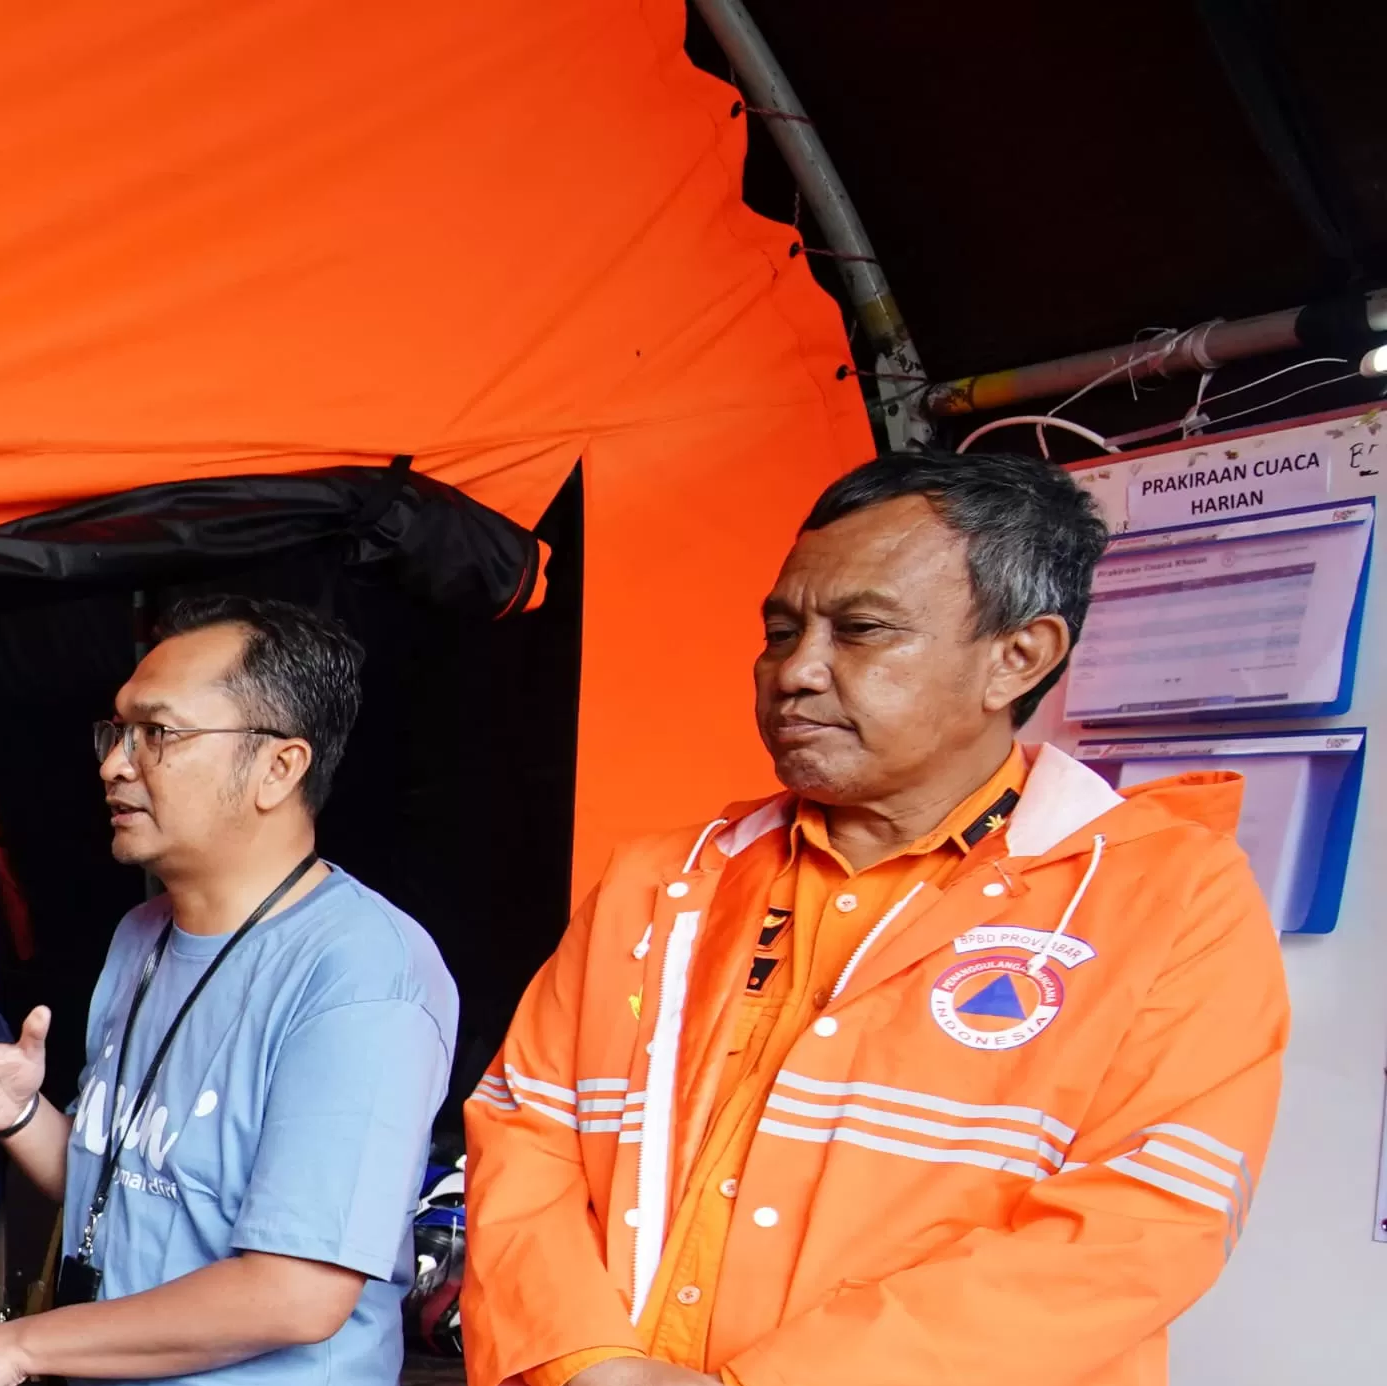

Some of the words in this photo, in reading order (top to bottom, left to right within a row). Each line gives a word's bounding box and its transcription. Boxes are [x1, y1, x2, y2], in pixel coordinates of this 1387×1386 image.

[1141, 463, 1247, 497] PRAKIRAAN
[1253, 452, 1320, 477] CUACA
[1191, 489, 1264, 515] HARIAN
[959, 934, 996, 945] BPBD
[942, 960, 1030, 990] PENANGGULANGA
[936, 1000, 1048, 1046] INDONESIA
